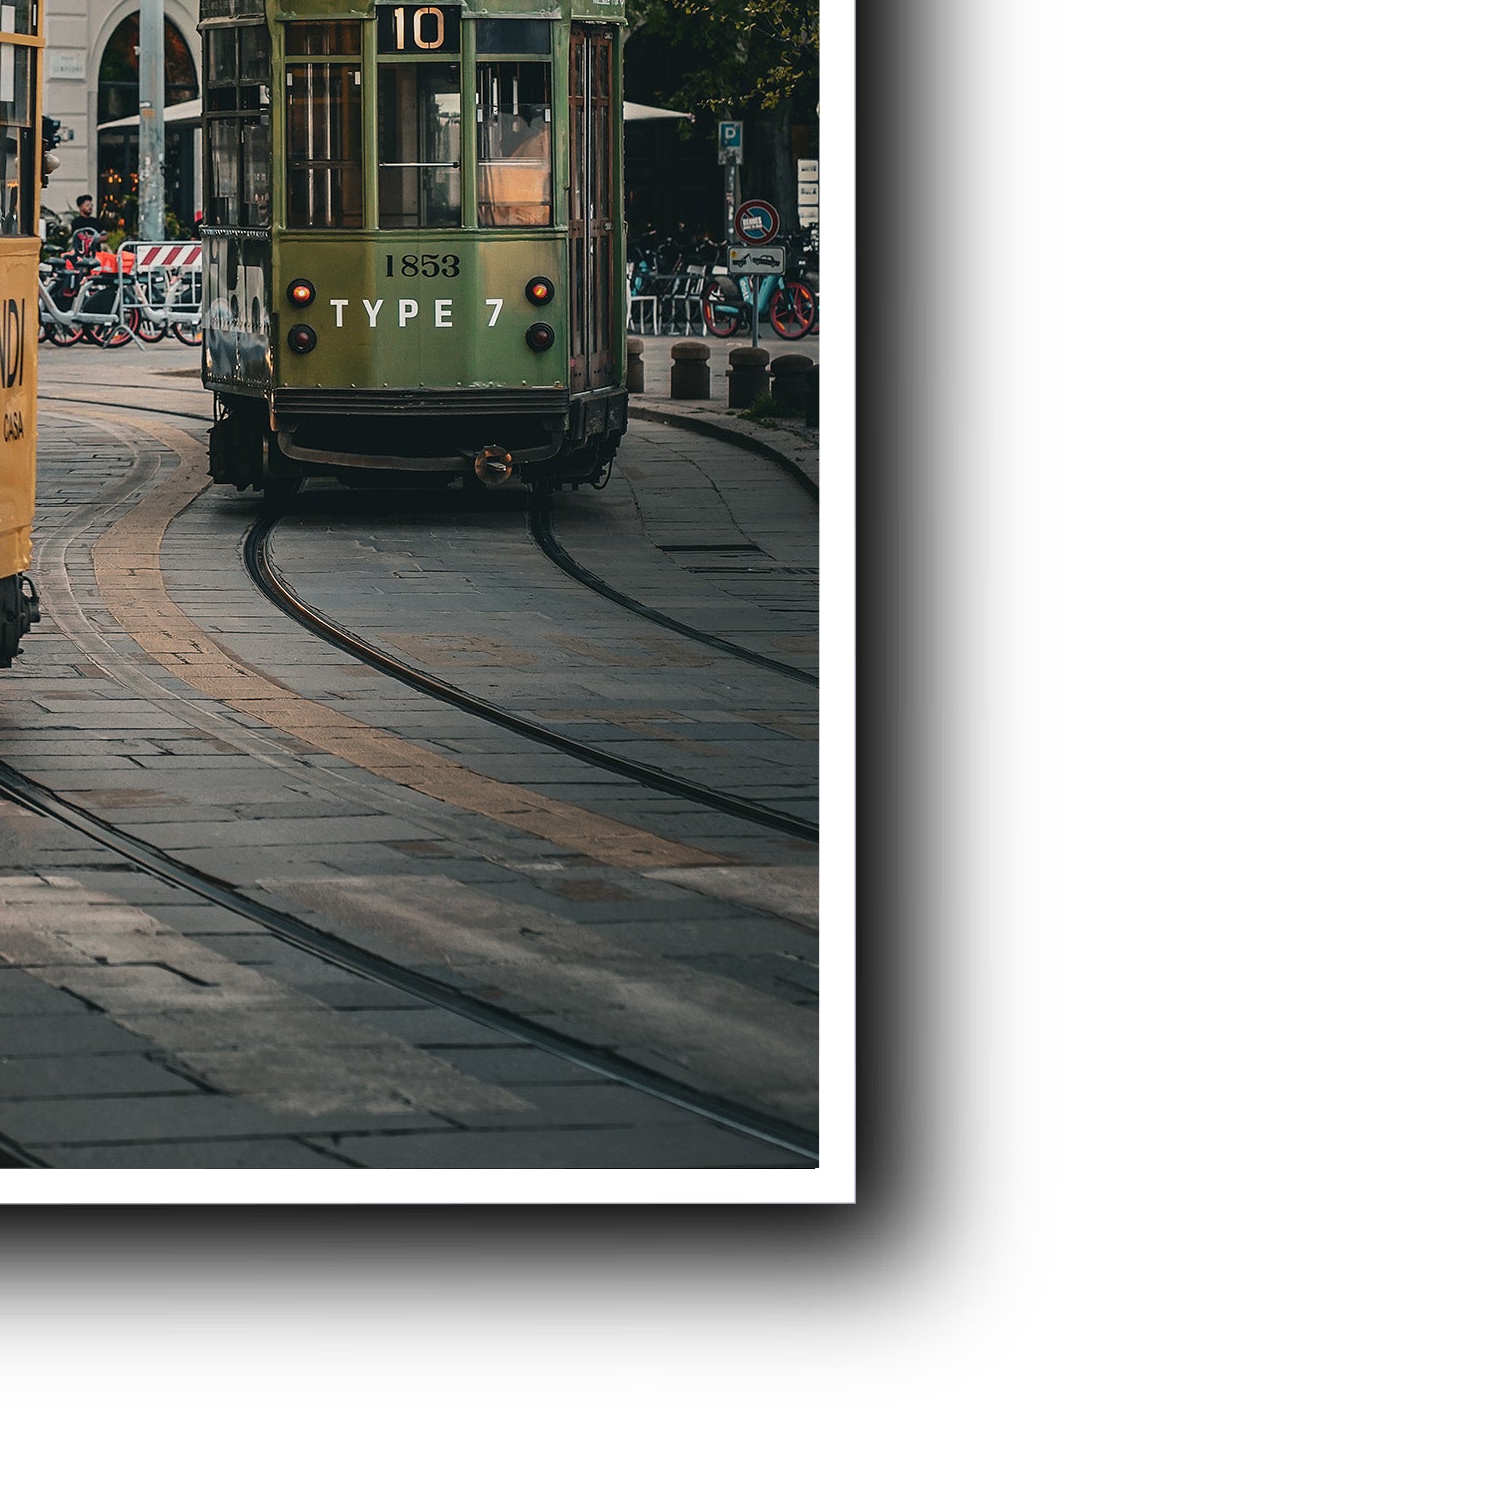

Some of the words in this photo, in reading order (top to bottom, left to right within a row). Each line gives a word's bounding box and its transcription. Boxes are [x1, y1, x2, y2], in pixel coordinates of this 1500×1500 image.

[393, 7, 445, 51] 10
[385, 253, 461, 279] 1853
[329, 299, 453, 328] TYPE
[485, 298, 504, 328] 7
[3, 411, 25, 443] CASA
